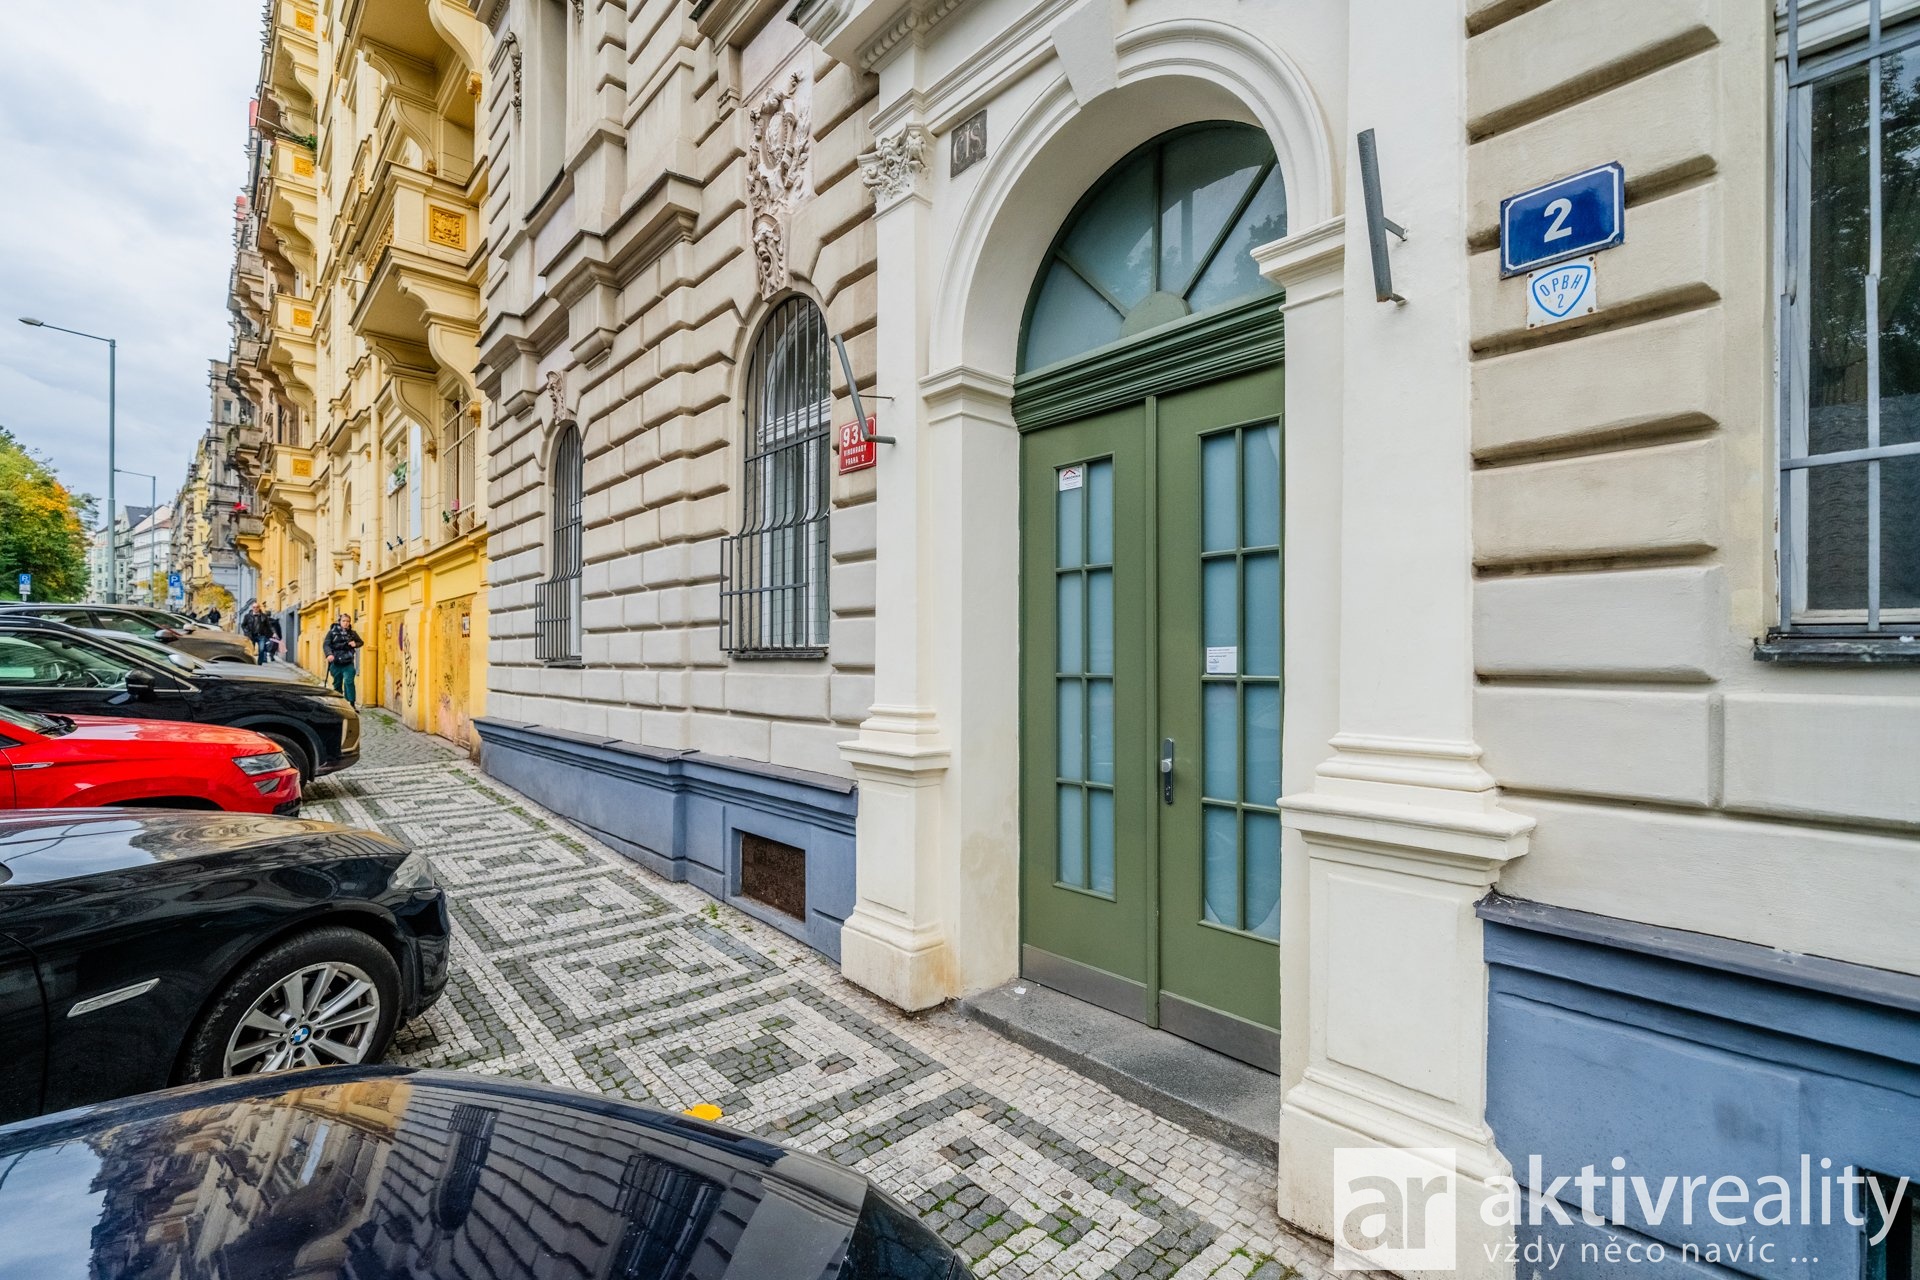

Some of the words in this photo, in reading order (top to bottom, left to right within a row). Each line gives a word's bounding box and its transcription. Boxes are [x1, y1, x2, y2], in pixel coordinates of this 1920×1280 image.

[1543, 197, 1573, 243] 2
[1539, 274, 1583, 297] OPBH
[1557, 293, 1564, 309] 2
